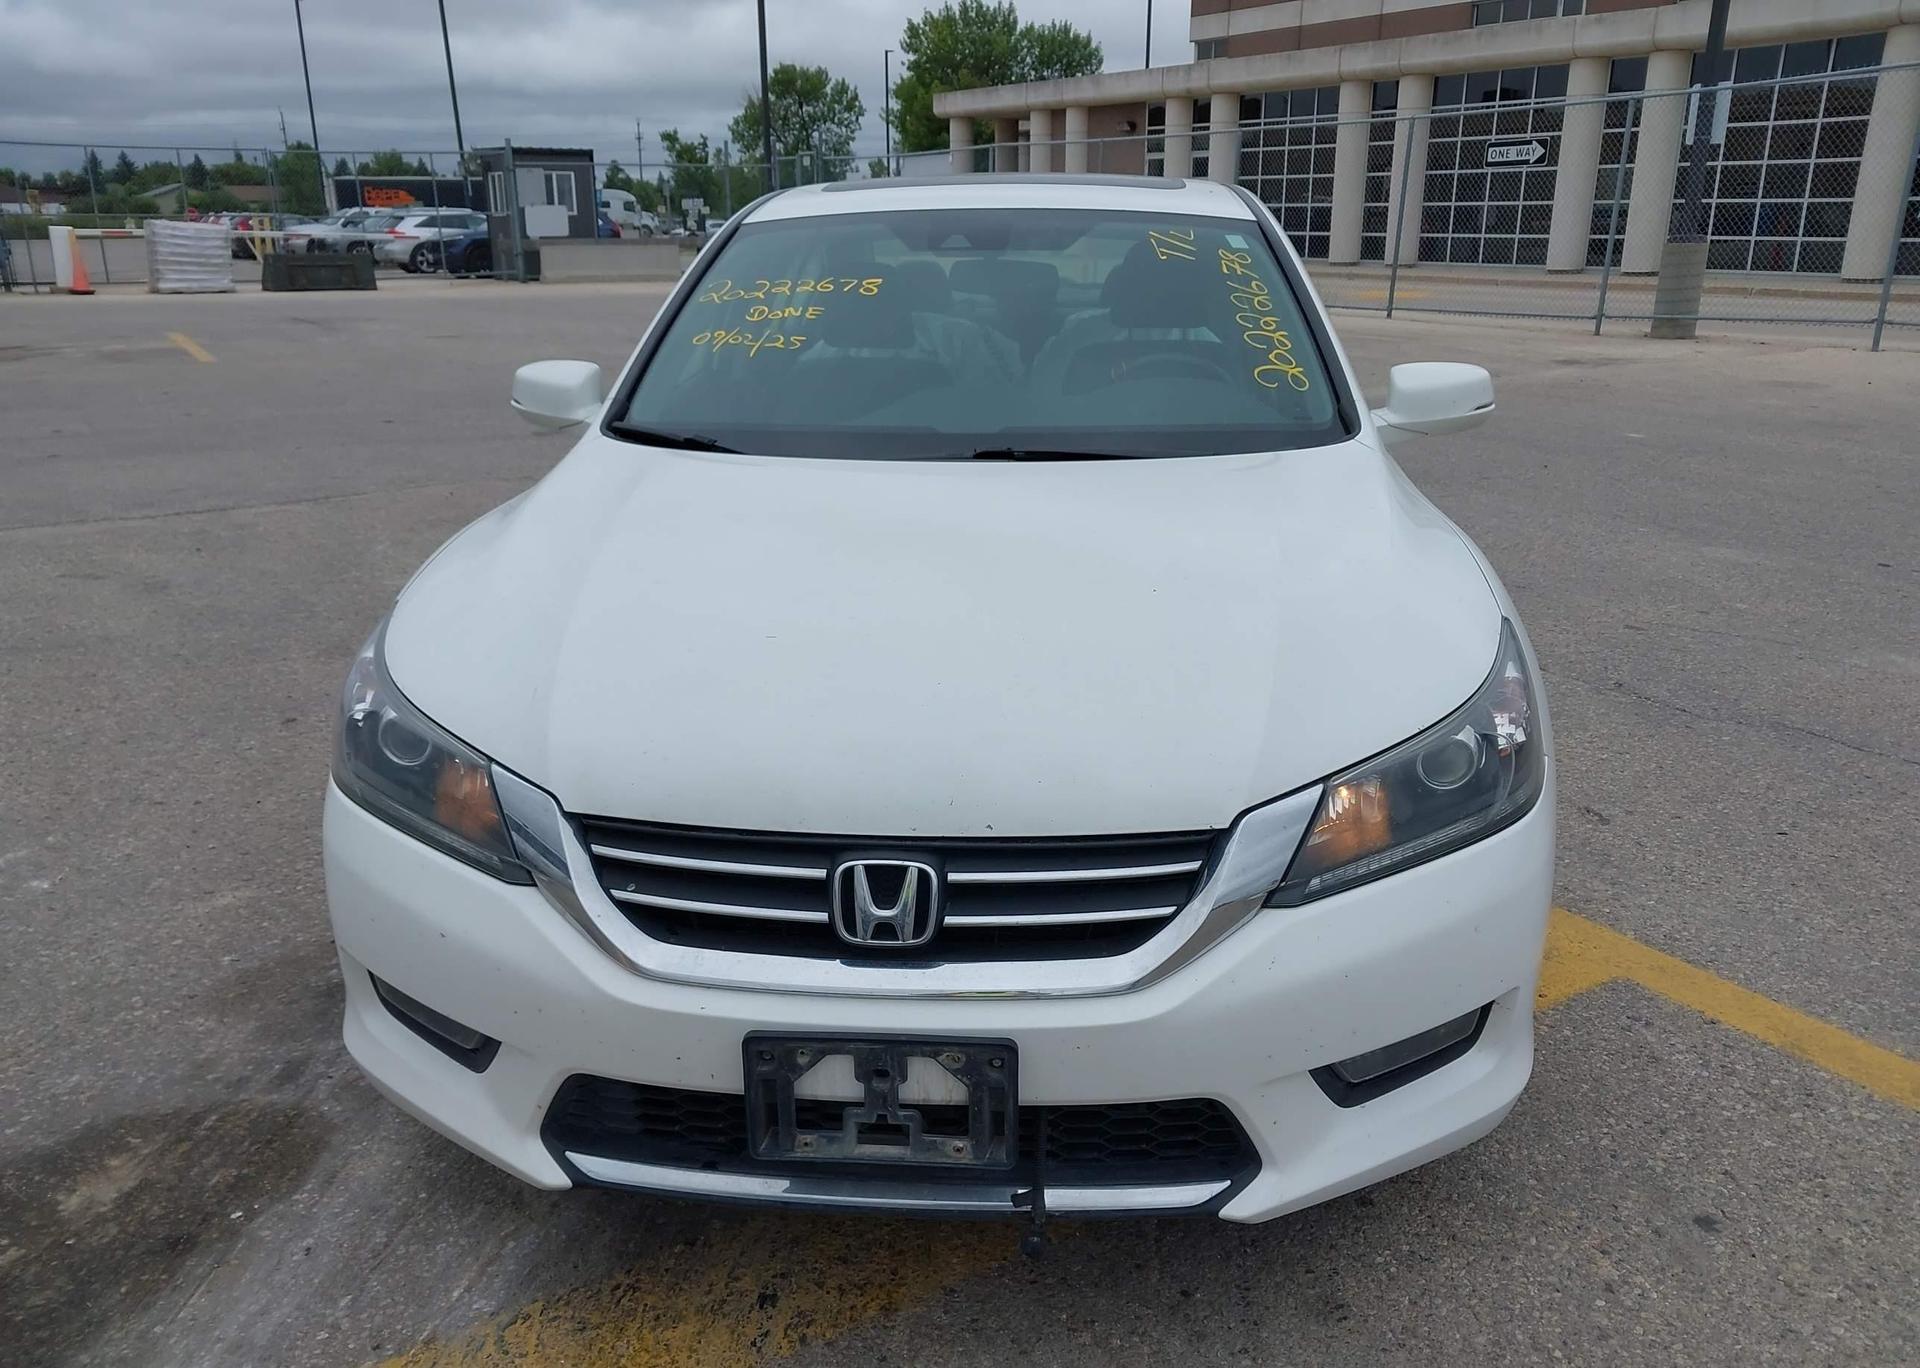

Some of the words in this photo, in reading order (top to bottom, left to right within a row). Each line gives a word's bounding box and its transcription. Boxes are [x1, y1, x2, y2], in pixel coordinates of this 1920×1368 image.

[1490, 149, 1511, 160] ONE
[1515, 146, 1537, 158] WAY
[700, 277, 883, 304] 20222678
[746, 305, 825, 321] DONE
[1218, 248, 1310, 391] 20222678
